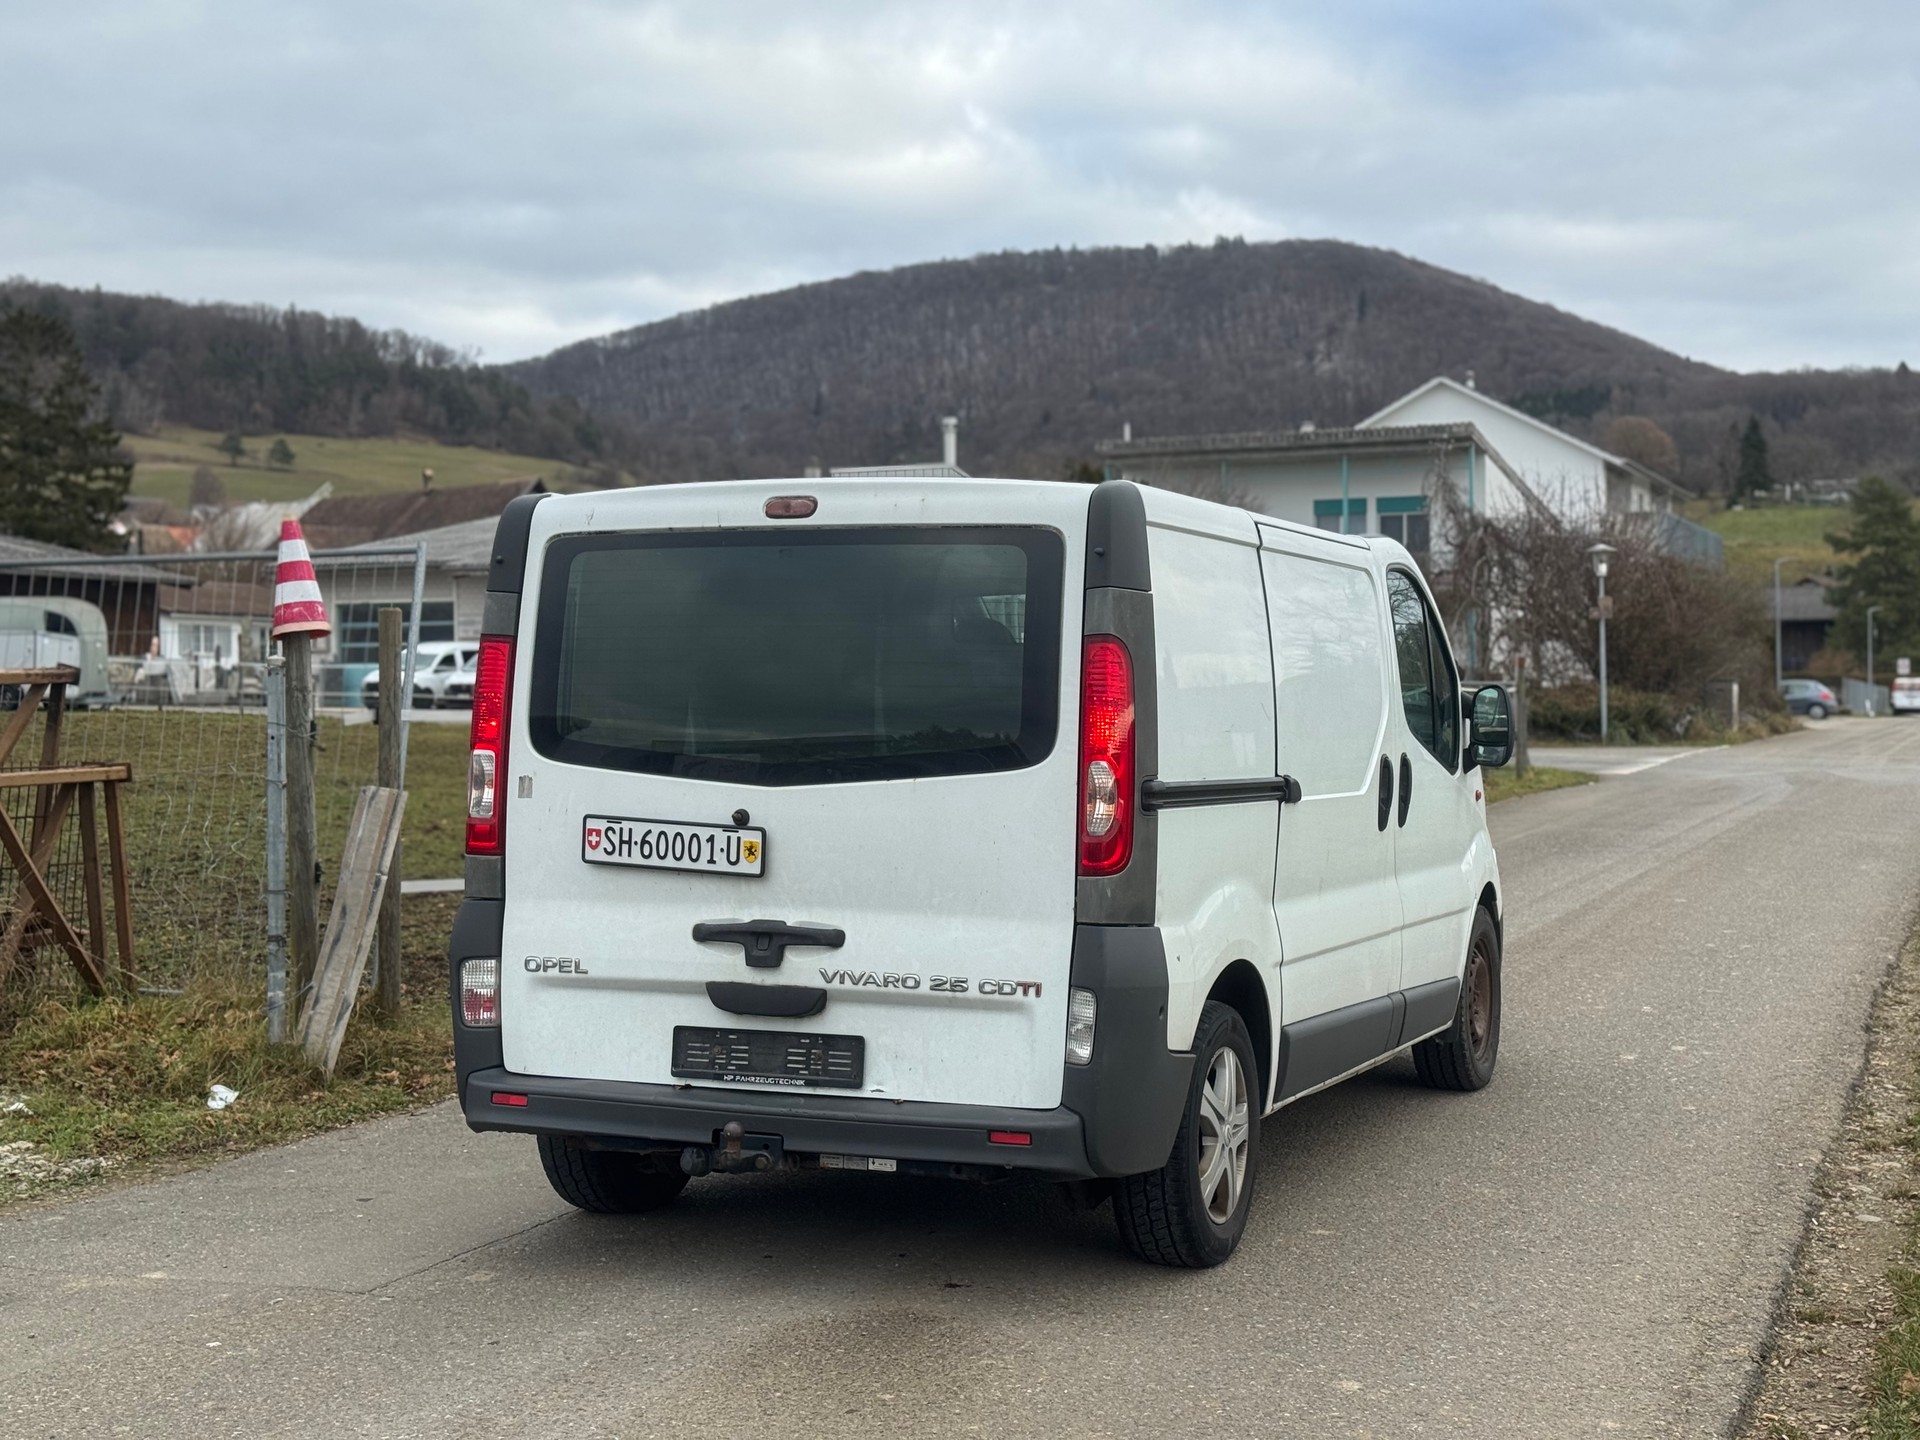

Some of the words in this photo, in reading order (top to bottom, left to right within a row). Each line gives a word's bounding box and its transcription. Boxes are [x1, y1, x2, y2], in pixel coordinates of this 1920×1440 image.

[524, 955, 589, 974] OPEL
[819, 968, 921, 989] VIVARO
[929, 975, 969, 993] 25
[978, 978, 1042, 998] CDTI
[735, 1075, 806, 1086] FAHRZEUGTECHNIK
